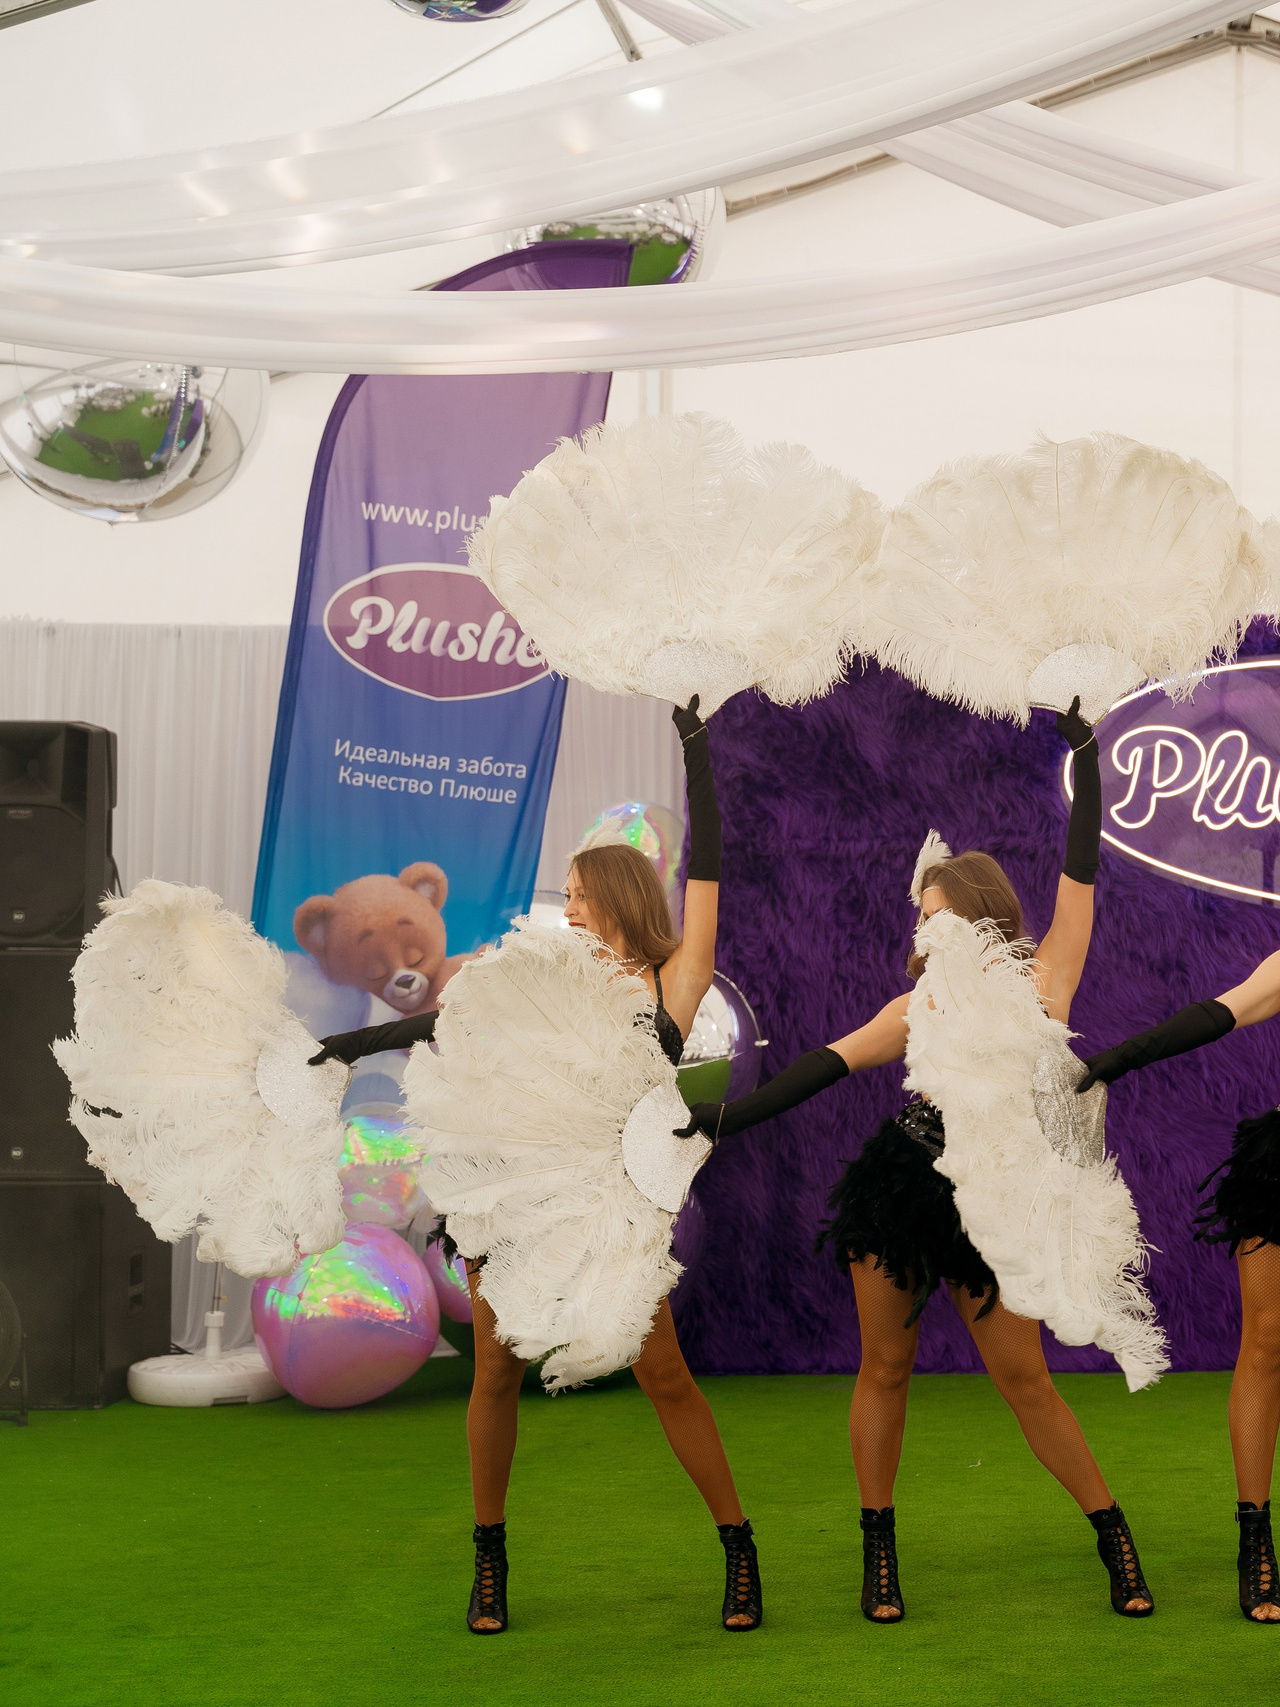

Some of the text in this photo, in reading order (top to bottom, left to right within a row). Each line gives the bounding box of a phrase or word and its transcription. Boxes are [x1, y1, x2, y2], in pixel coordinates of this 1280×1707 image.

[334, 738, 527, 779] Идеальная забота
[338, 765, 518, 805] Качество Плюше
